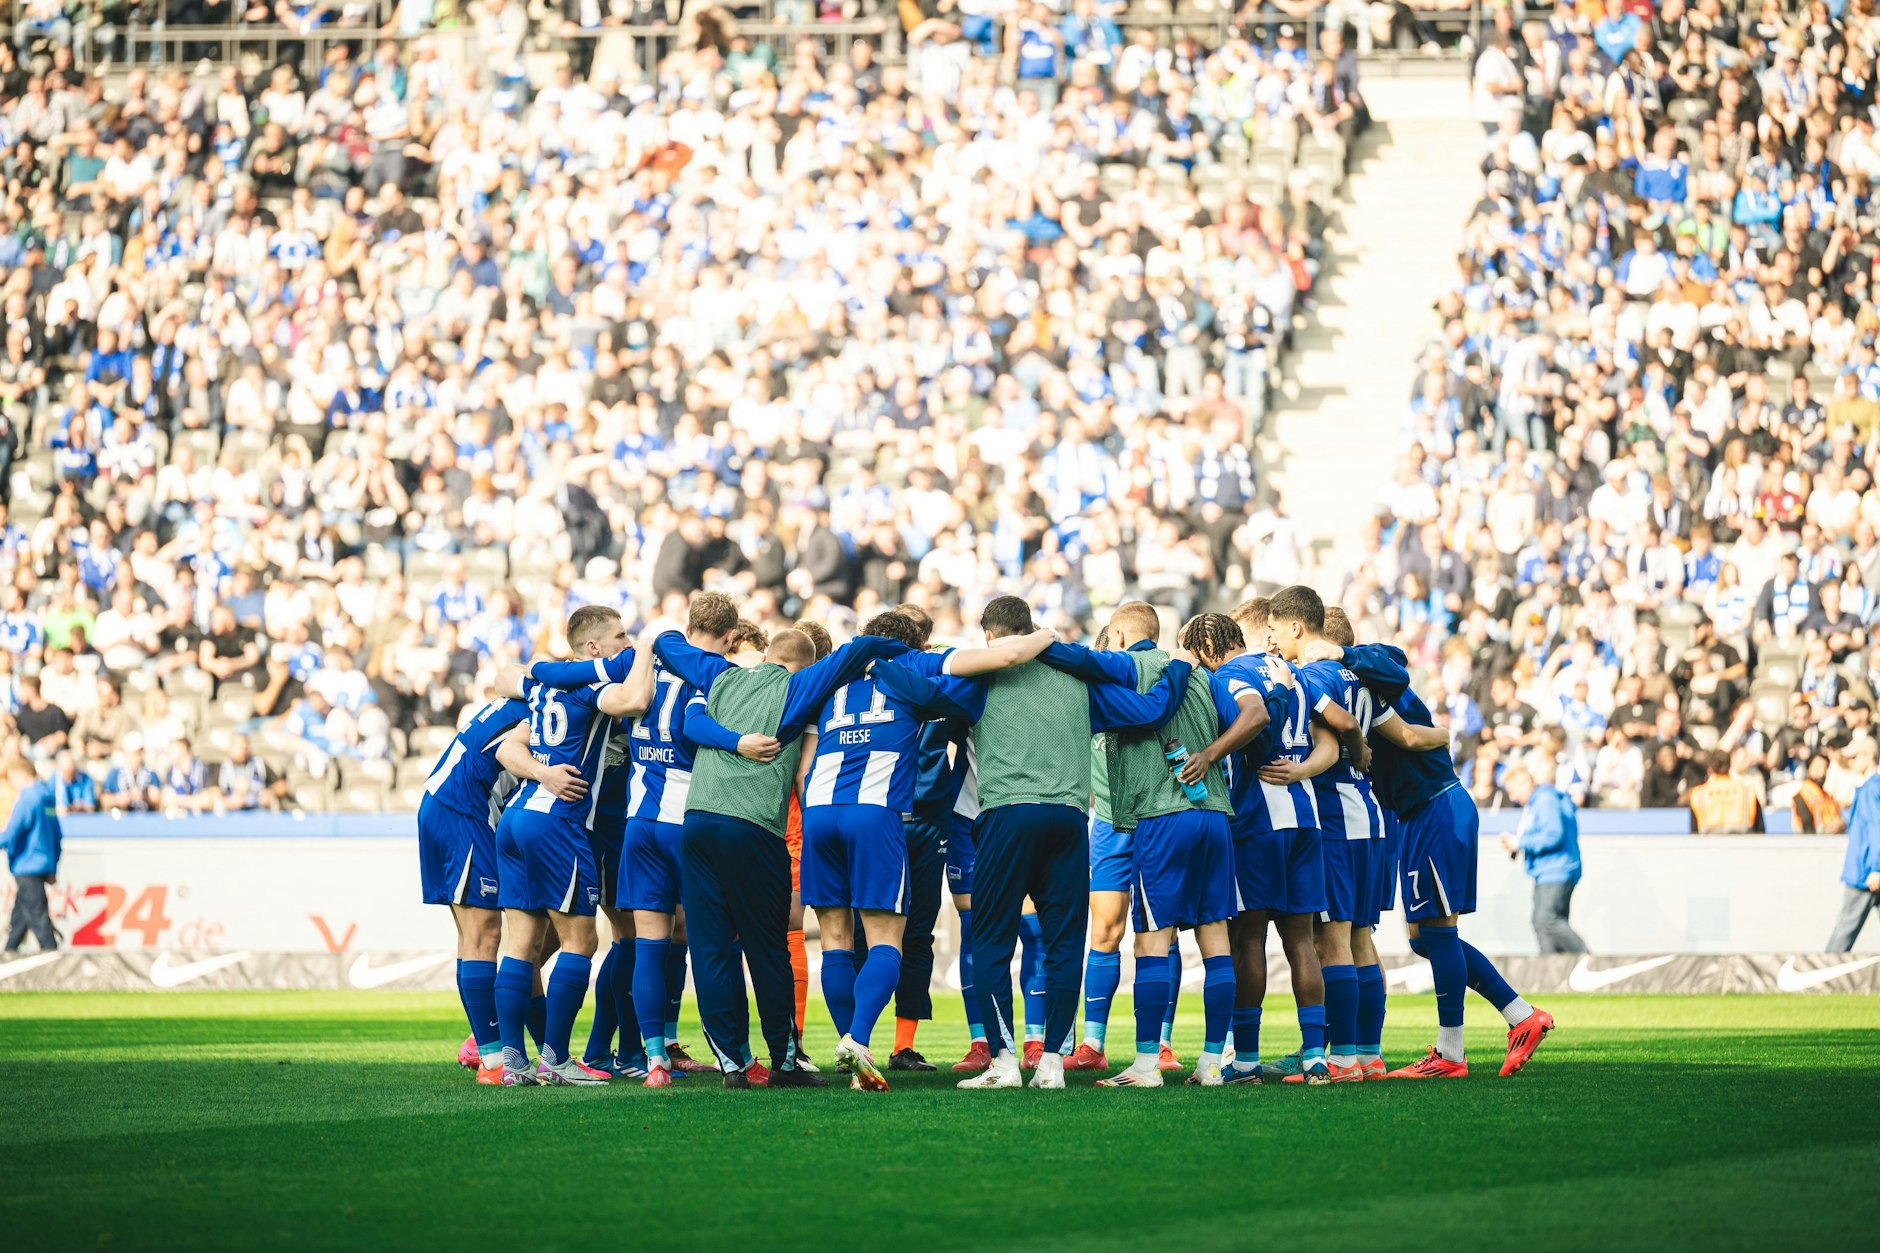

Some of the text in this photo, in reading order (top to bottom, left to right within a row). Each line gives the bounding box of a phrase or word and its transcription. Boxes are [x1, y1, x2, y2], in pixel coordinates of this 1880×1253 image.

[528, 682, 568, 747] 16
[825, 673, 895, 733] 11
[1343, 685, 1373, 758] 10
[839, 729, 871, 745] REESE
[1407, 870, 1420, 900] 7
